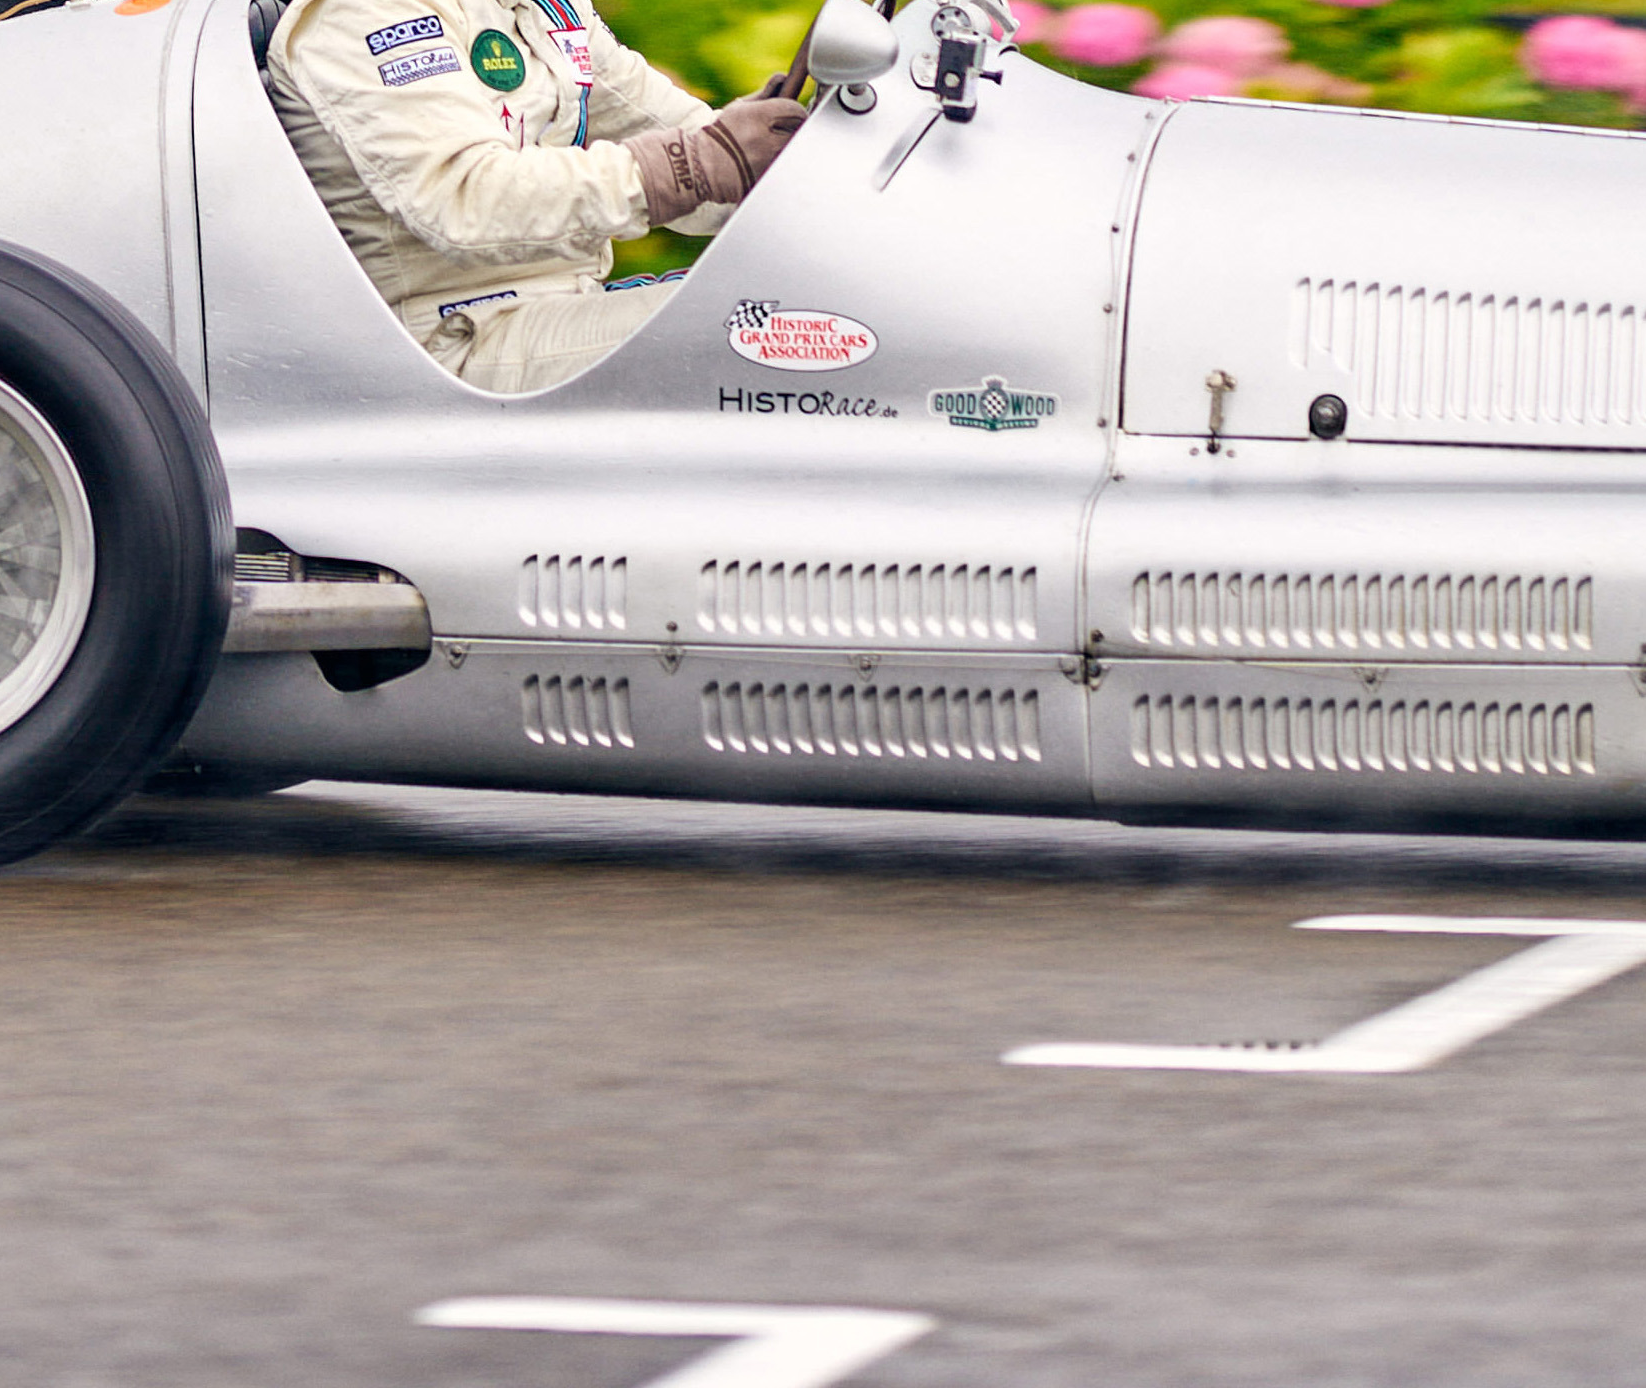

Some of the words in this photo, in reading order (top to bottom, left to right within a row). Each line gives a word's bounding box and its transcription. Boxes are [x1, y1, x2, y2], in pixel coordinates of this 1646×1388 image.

[368, 16, 441, 49] sparco
[482, 56, 518, 71] ROLEX
[668, 141, 694, 191] OMP
[739, 330, 790, 345] GRAND
[793, 332, 826, 347] PRIX
[829, 333, 868, 348] CARS
[758, 345, 852, 362] ASSOCIATION
